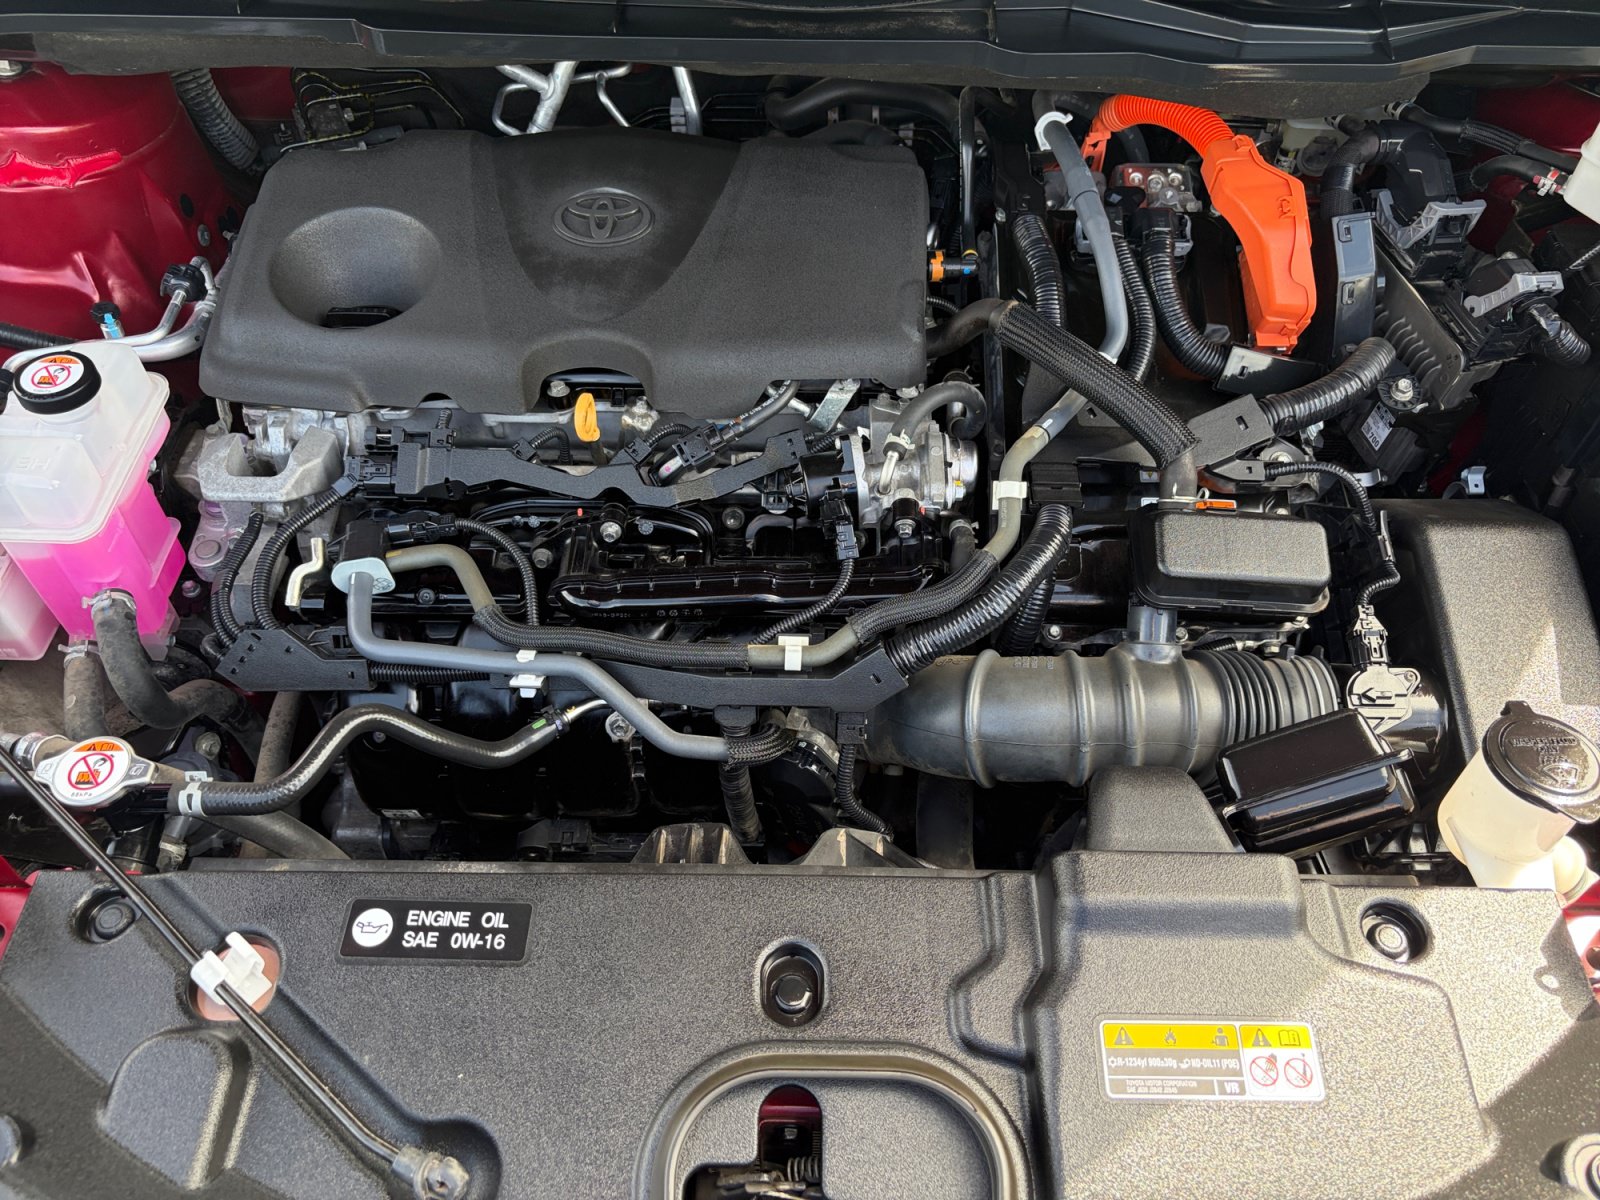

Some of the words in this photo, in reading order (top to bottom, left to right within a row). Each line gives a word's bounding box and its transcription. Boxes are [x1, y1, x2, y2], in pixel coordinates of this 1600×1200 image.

[1368, 431, 1380, 447] 700
[406, 910, 471, 927] ENGINE
[481, 912, 509, 928] OIL
[402, 931, 439, 948] SAE
[450, 933, 506, 949] 0W-16
[1224, 1082, 1240, 1094] VR
